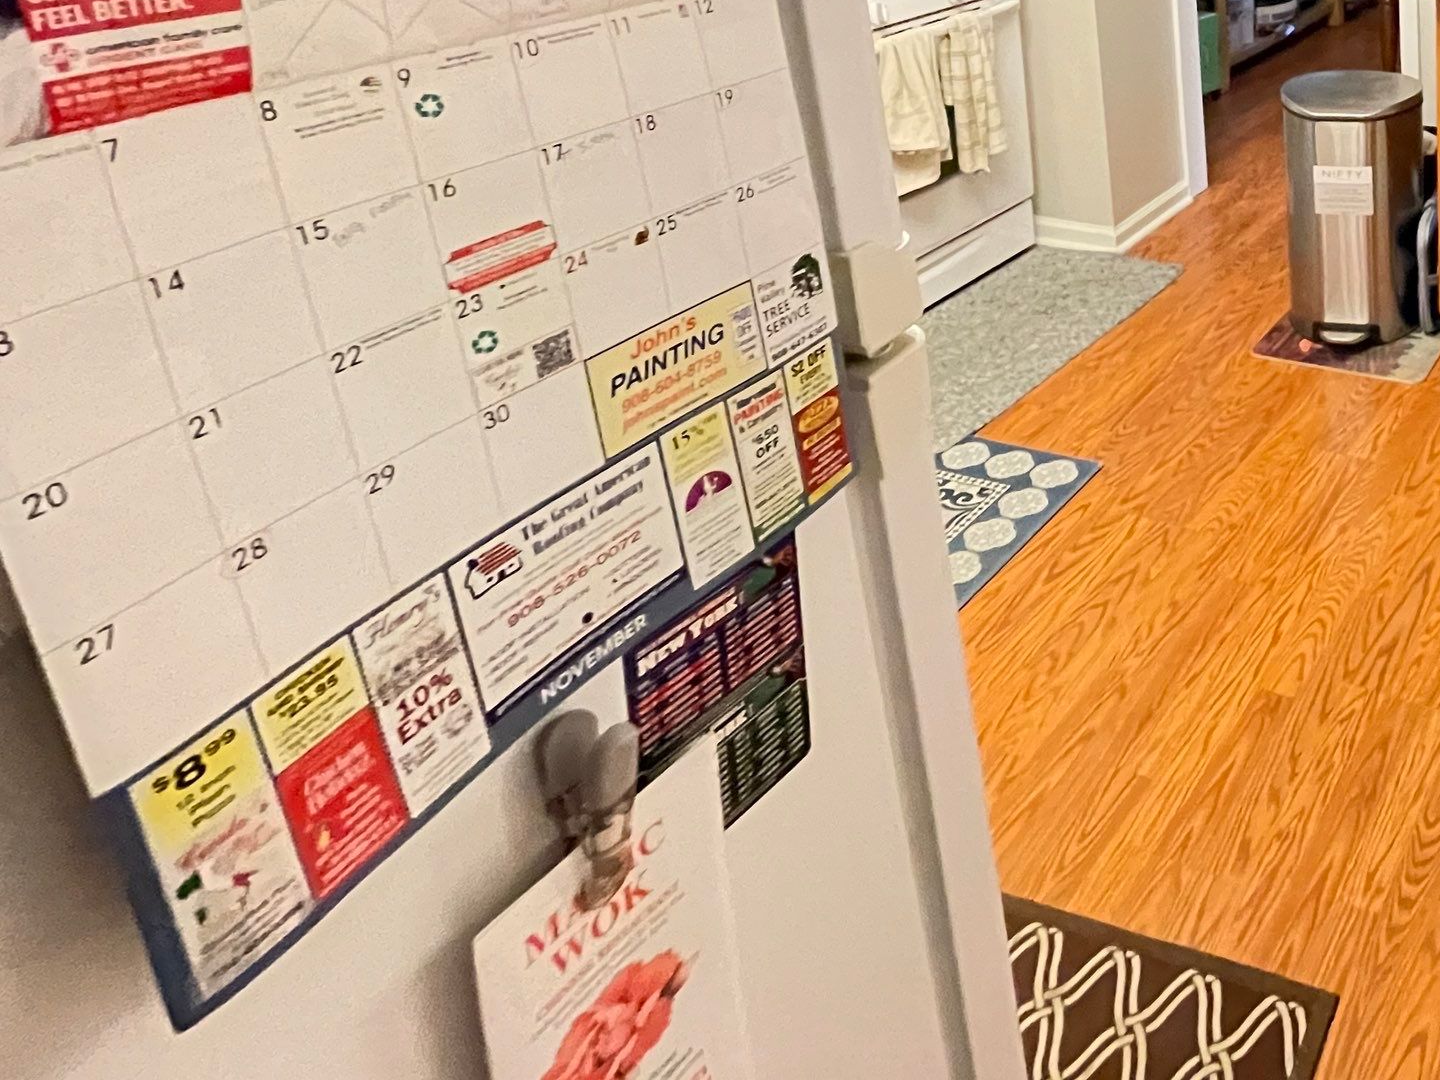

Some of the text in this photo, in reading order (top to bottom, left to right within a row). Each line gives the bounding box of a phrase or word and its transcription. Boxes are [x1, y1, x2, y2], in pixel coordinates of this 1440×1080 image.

[30, 4, 91, 32] FEEL
[611, 16, 630, 36] 11
[513, 38, 540, 60] 10
[396, 68, 411, 88] 9
[259, 100, 278, 121] 8
[715, 88, 735, 108] 19
[634, 114, 657, 135] 18
[102, 138, 118, 162] 7
[541, 143, 564, 166] 17
[427, 179, 457, 202] 16
[735, 184, 755, 204] 26
[295, 219, 330, 246] 15
[655, 216, 678, 236] 25
[564, 251, 589, 275] 24
[147, 269, 186, 299] 14
[455, 293, 484, 320] 23
[762, 299, 792, 322] TREE
[766, 302, 811, 338] SERVICE
[630, 316, 697, 360] John's
[329, 345, 365, 374] 22
[609, 322, 725, 399] PAINTING
[188, 407, 223, 440] 21
[483, 404, 510, 430] 30
[755, 436, 781, 459] OFF
[363, 464, 396, 495] 29
[21, 481, 69, 520] 20
[520, 518, 548, 542] The
[231, 536, 269, 572] 28
[507, 529, 643, 630] 908-526-0072
[75, 623, 116, 666] 27
[539, 613, 649, 706] NOVEMBER
[395, 667, 454, 722] 10%
[396, 687, 463, 747] Extra
[550, 869, 654, 974] WOK
